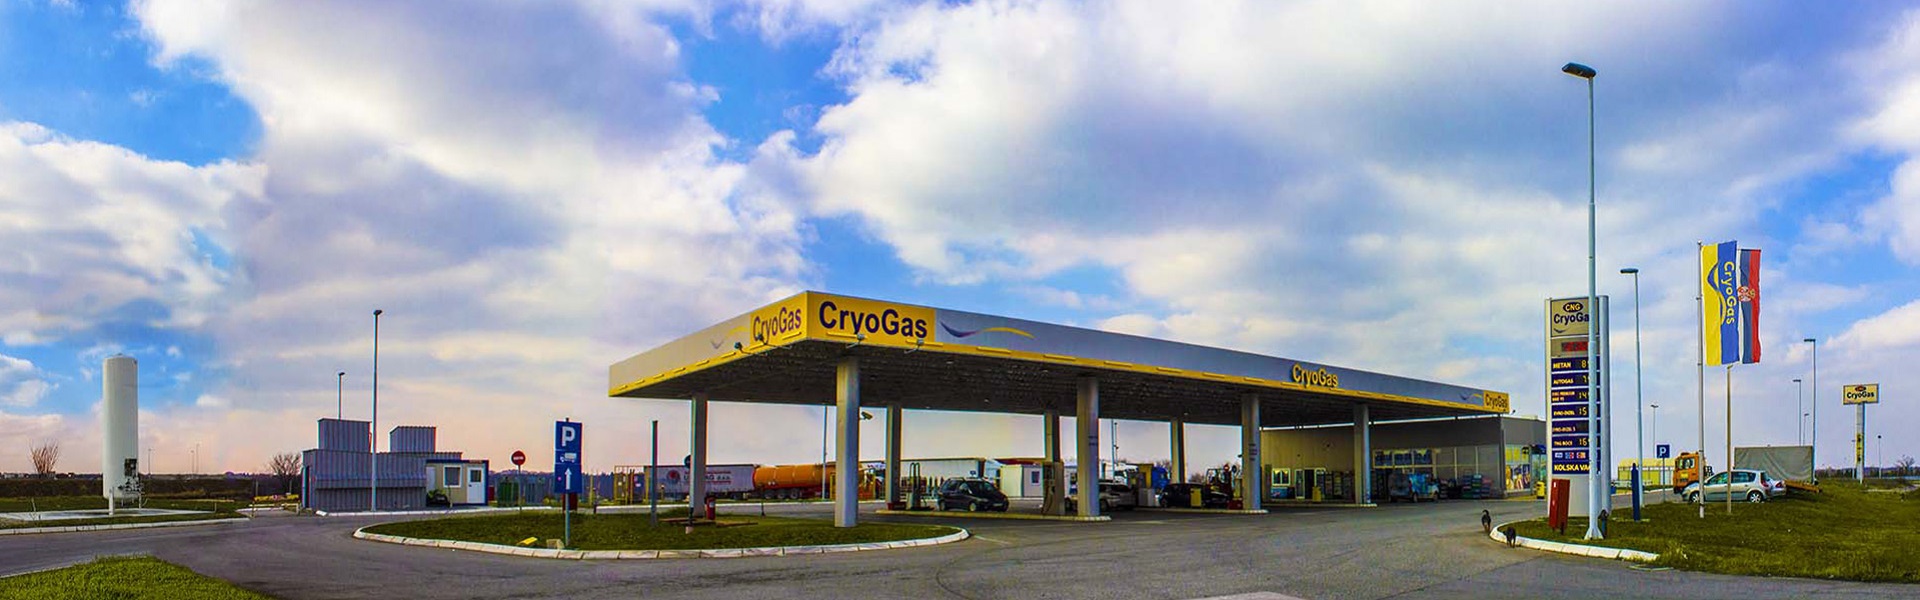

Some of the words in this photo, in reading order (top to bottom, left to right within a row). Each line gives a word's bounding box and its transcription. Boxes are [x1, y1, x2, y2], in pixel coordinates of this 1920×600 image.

[1720, 261, 1738, 325] CryoGas
[1565, 303, 1581, 311] CNG
[752, 306, 802, 344] CryoGas
[819, 300, 928, 339] CryoGas
[1554, 312, 1590, 326] CryoGa
[1291, 363, 1339, 388] CryoGas
[1484, 394, 1508, 410] CryoGas
[1846, 390, 1875, 400] CryoGas
[561, 425, 576, 447] P
[1659, 446, 1667, 456] P
[1553, 463, 1580, 471] KOLSKA
